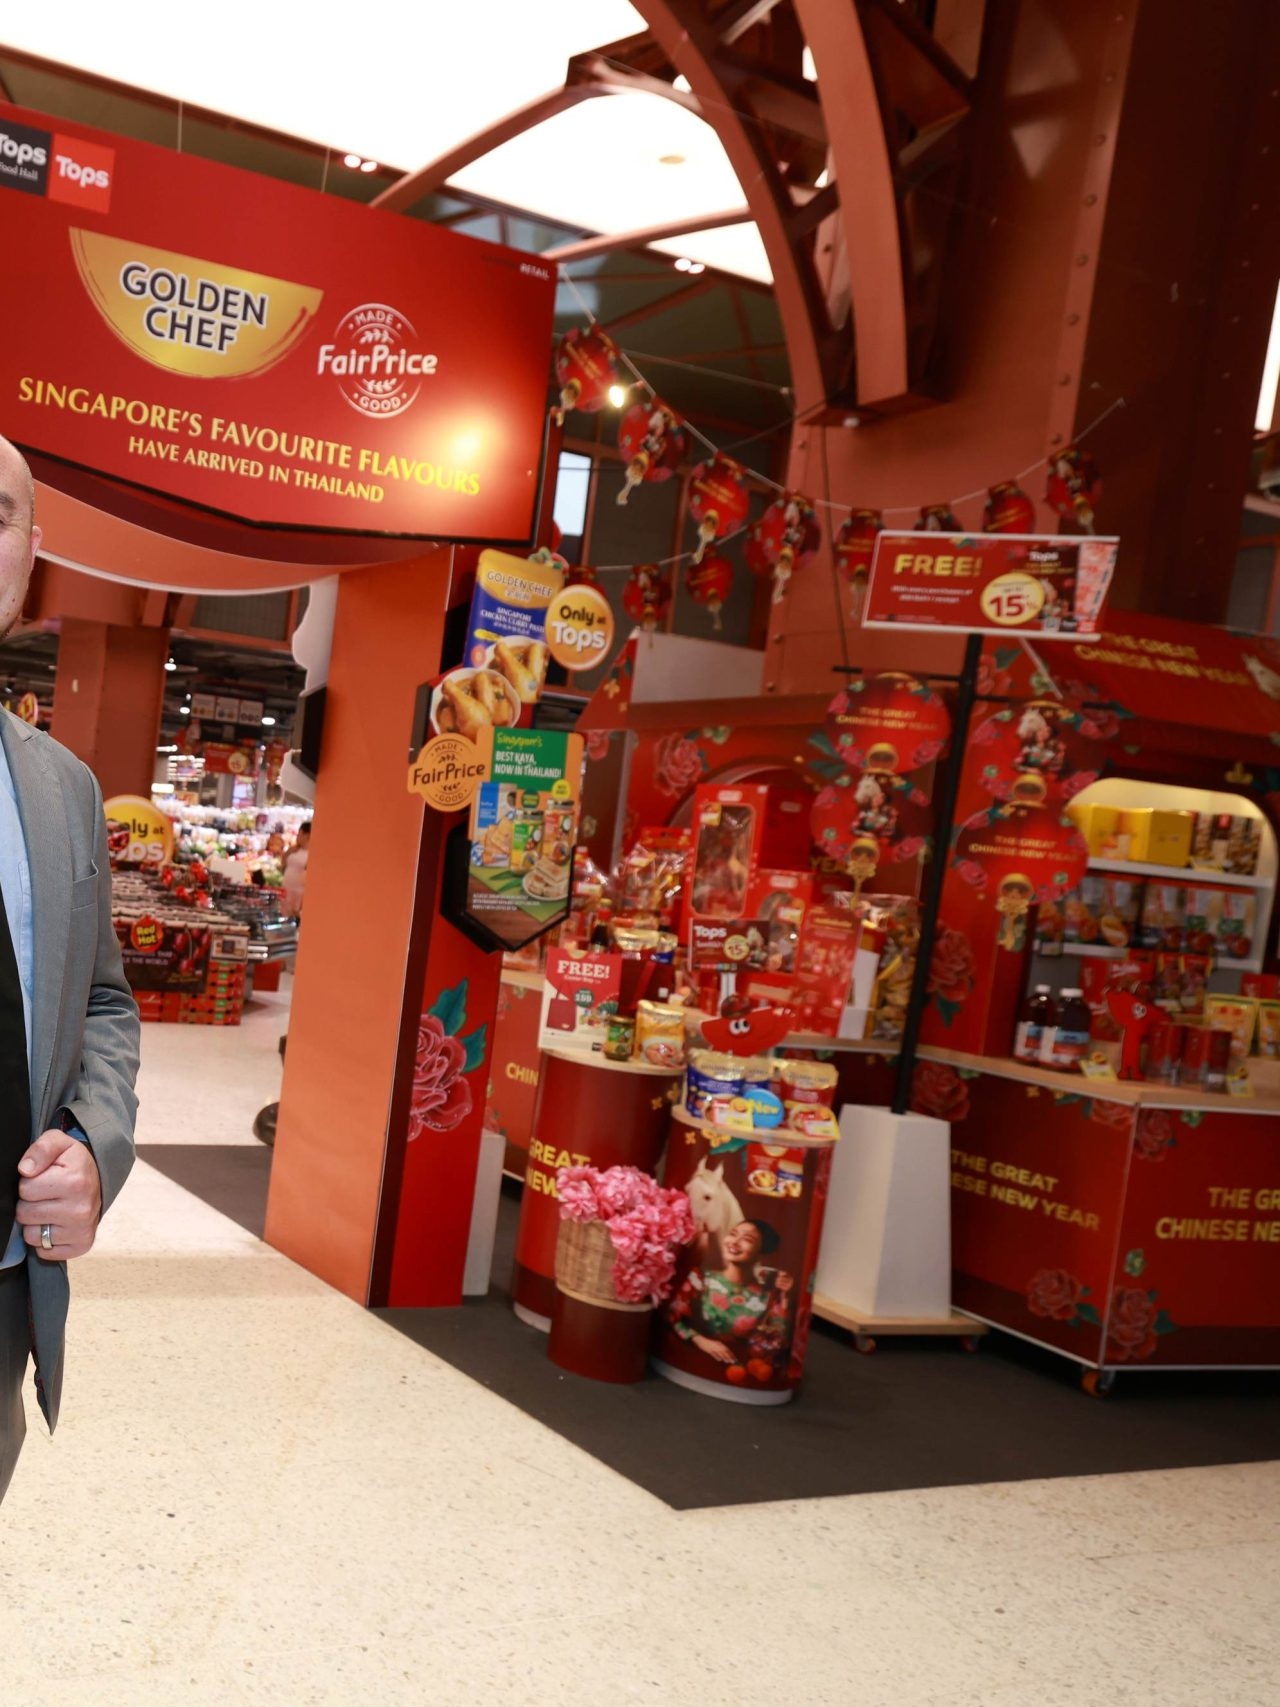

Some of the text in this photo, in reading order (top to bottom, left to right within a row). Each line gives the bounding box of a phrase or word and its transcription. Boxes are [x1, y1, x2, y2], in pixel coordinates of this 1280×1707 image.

[19, 166, 39, 181] Hall
[55, 154, 110, 188] Tops
[121, 260, 269, 328] GOLDEN
[354, 310, 394, 325] MADE
[144, 306, 239, 354] CHEF
[317, 344, 438, 375] FairPrice
[359, 396, 401, 412] GOOD
[19, 376, 481, 497] SINGAPORE'S FAVOURITE FLAVOURS
[128, 436, 385, 503] HAVE ARRIVED IN THAILAND
[894, 553, 984, 577] FREE!
[1028, 550, 1059, 561] Tops
[487, 570, 553, 597] GOLDEN CHEF
[496, 606, 533, 622] SINGAPORE
[559, 605, 595, 627] Only
[989, 594, 1025, 618] 15
[551, 620, 607, 653] Tops
[434, 743, 458, 752] MADE
[495, 751, 537, 765] BEST KAYA,
[412, 761, 486, 786] FairPrice
[494, 763, 562, 778] NOW IN THAILAND!
[438, 792, 464, 803] GOOD
[153, 826, 164, 835] at
[136, 925, 156, 935] Red
[138, 934, 156, 945] Hot
[693, 925, 727, 940] Tops
[557, 959, 611, 980] FREE!
[750, 1099, 780, 1116] New
[990, 1161, 1060, 1193] GREAT
[990, 1185, 1100, 1231] NEW YEAR
[1208, 1186, 1251, 1210] THE
[1155, 1217, 1249, 1241] CHINESE
